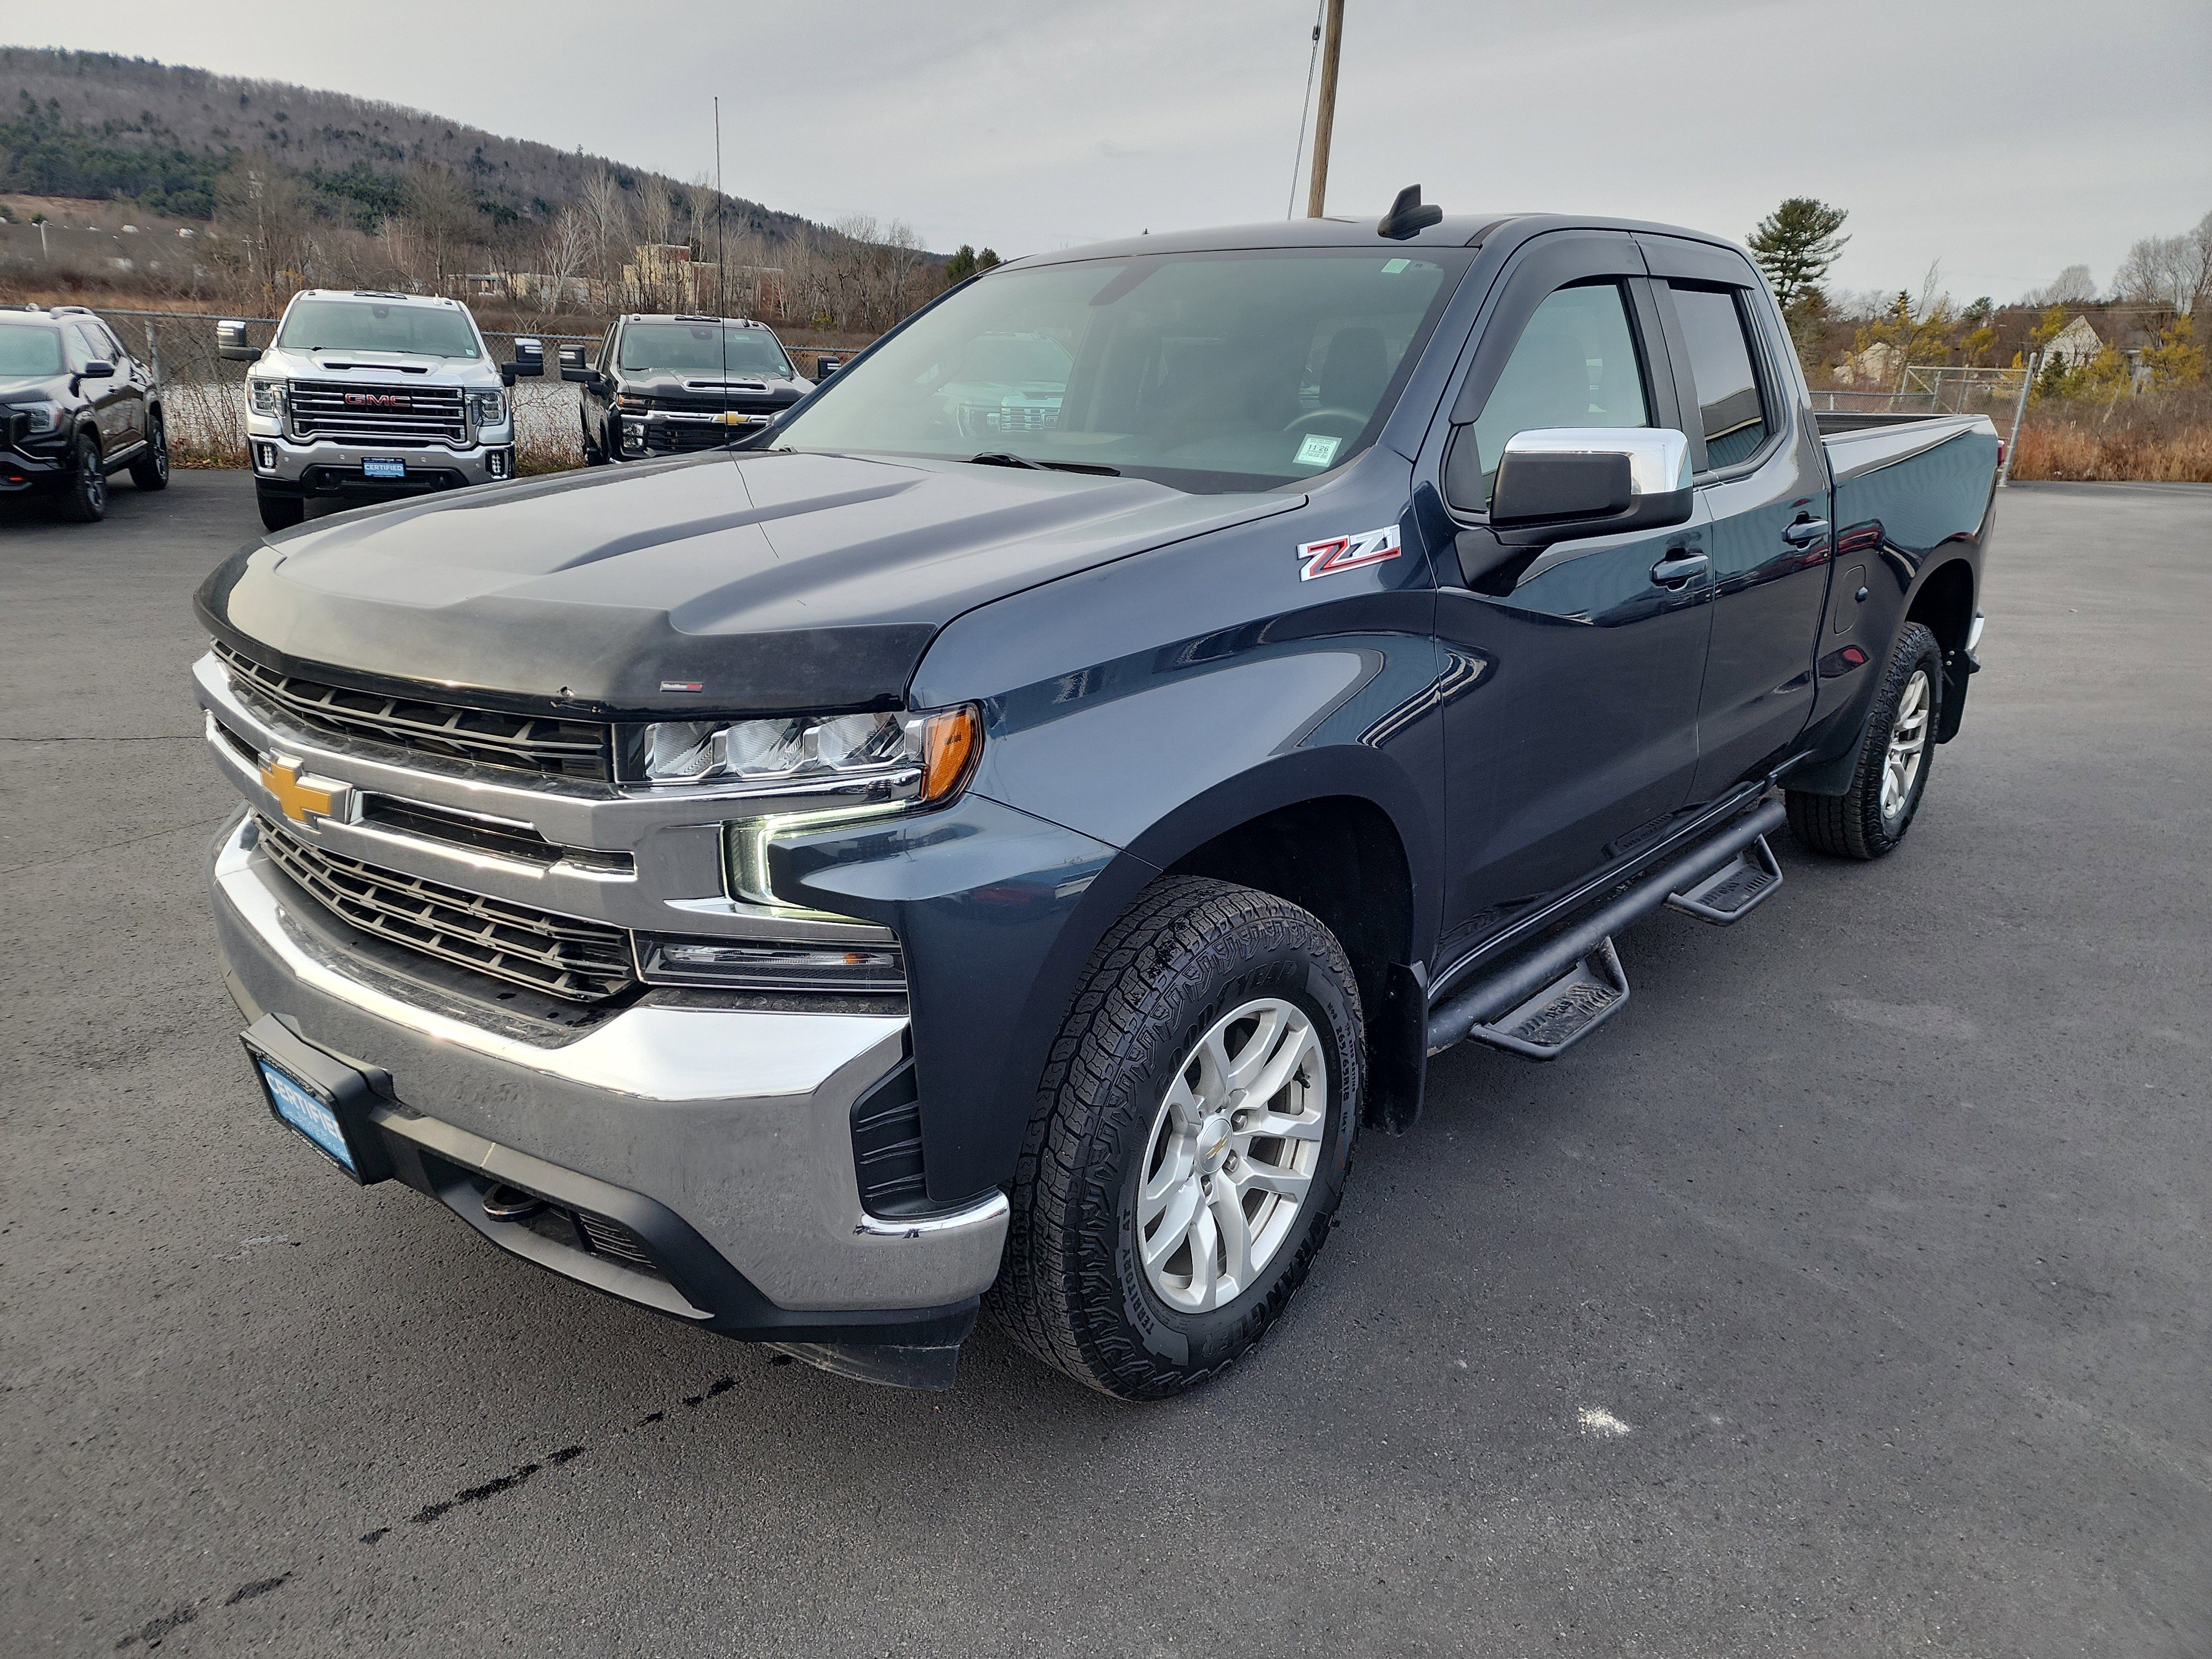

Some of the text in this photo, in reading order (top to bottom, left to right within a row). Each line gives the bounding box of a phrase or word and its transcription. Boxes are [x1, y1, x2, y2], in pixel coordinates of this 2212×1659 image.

[345, 393, 411, 407] GMC
[1296, 524, 1401, 582] Z71
[1122, 1248, 1155, 1335] TERRITORY
